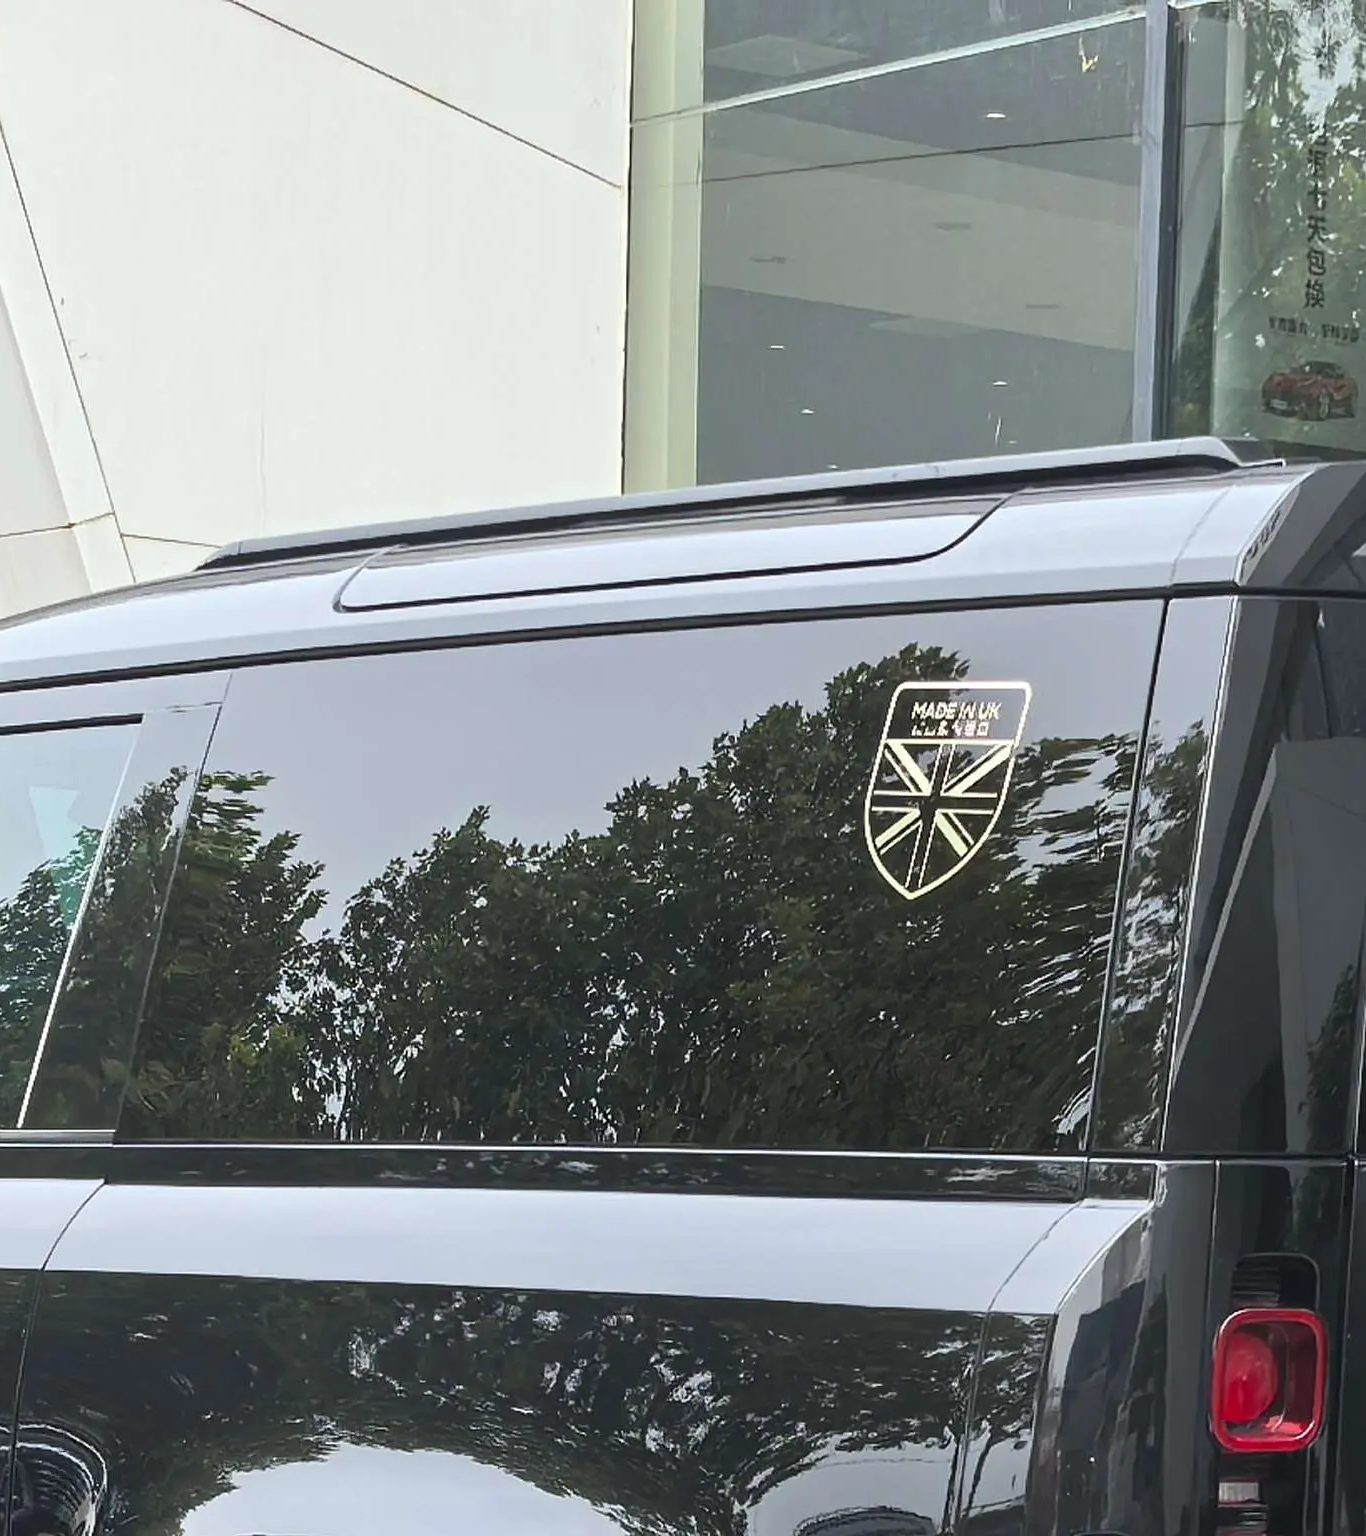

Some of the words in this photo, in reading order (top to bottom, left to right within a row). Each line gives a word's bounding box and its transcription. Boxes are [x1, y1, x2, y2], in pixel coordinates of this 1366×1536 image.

[911, 701, 958, 720] MADE
[958, 701, 977, 720] IN
[978, 702, 1001, 719] UK
